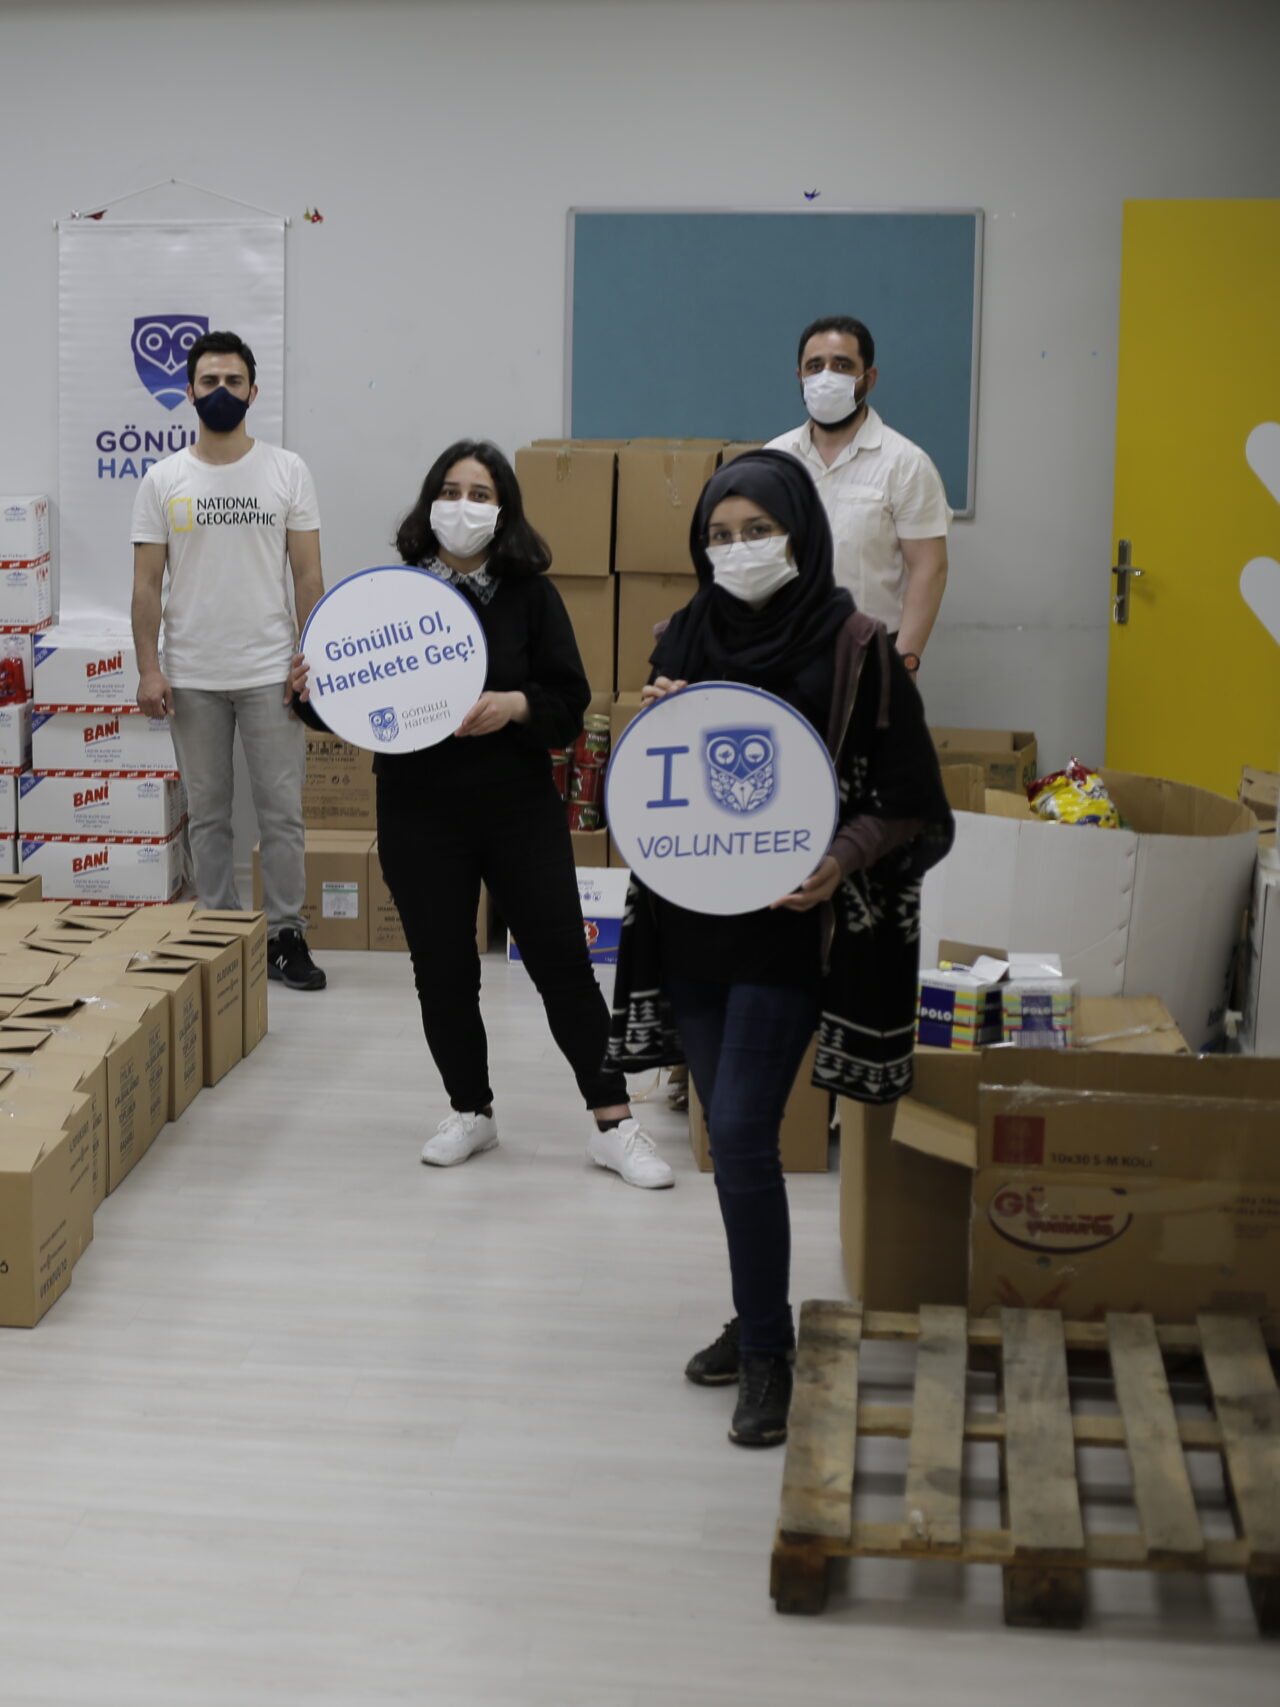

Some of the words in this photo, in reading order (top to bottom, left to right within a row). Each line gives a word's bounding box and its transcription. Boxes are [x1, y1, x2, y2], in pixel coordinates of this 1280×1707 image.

[197, 497, 260, 511] NATIONAL
[196, 511, 277, 527] GEOGRAPHIC
[325, 621, 413, 661] Gönüllü
[419, 611, 451, 636] Ol,
[315, 655, 419, 696] Harekete
[424, 634, 475, 666] Geç!
[646, 746, 689, 809] I
[637, 829, 811, 859] VOLUNTEER
[921, 1007, 952, 1021] POLO
[1023, 1006, 1051, 1016] POLO
